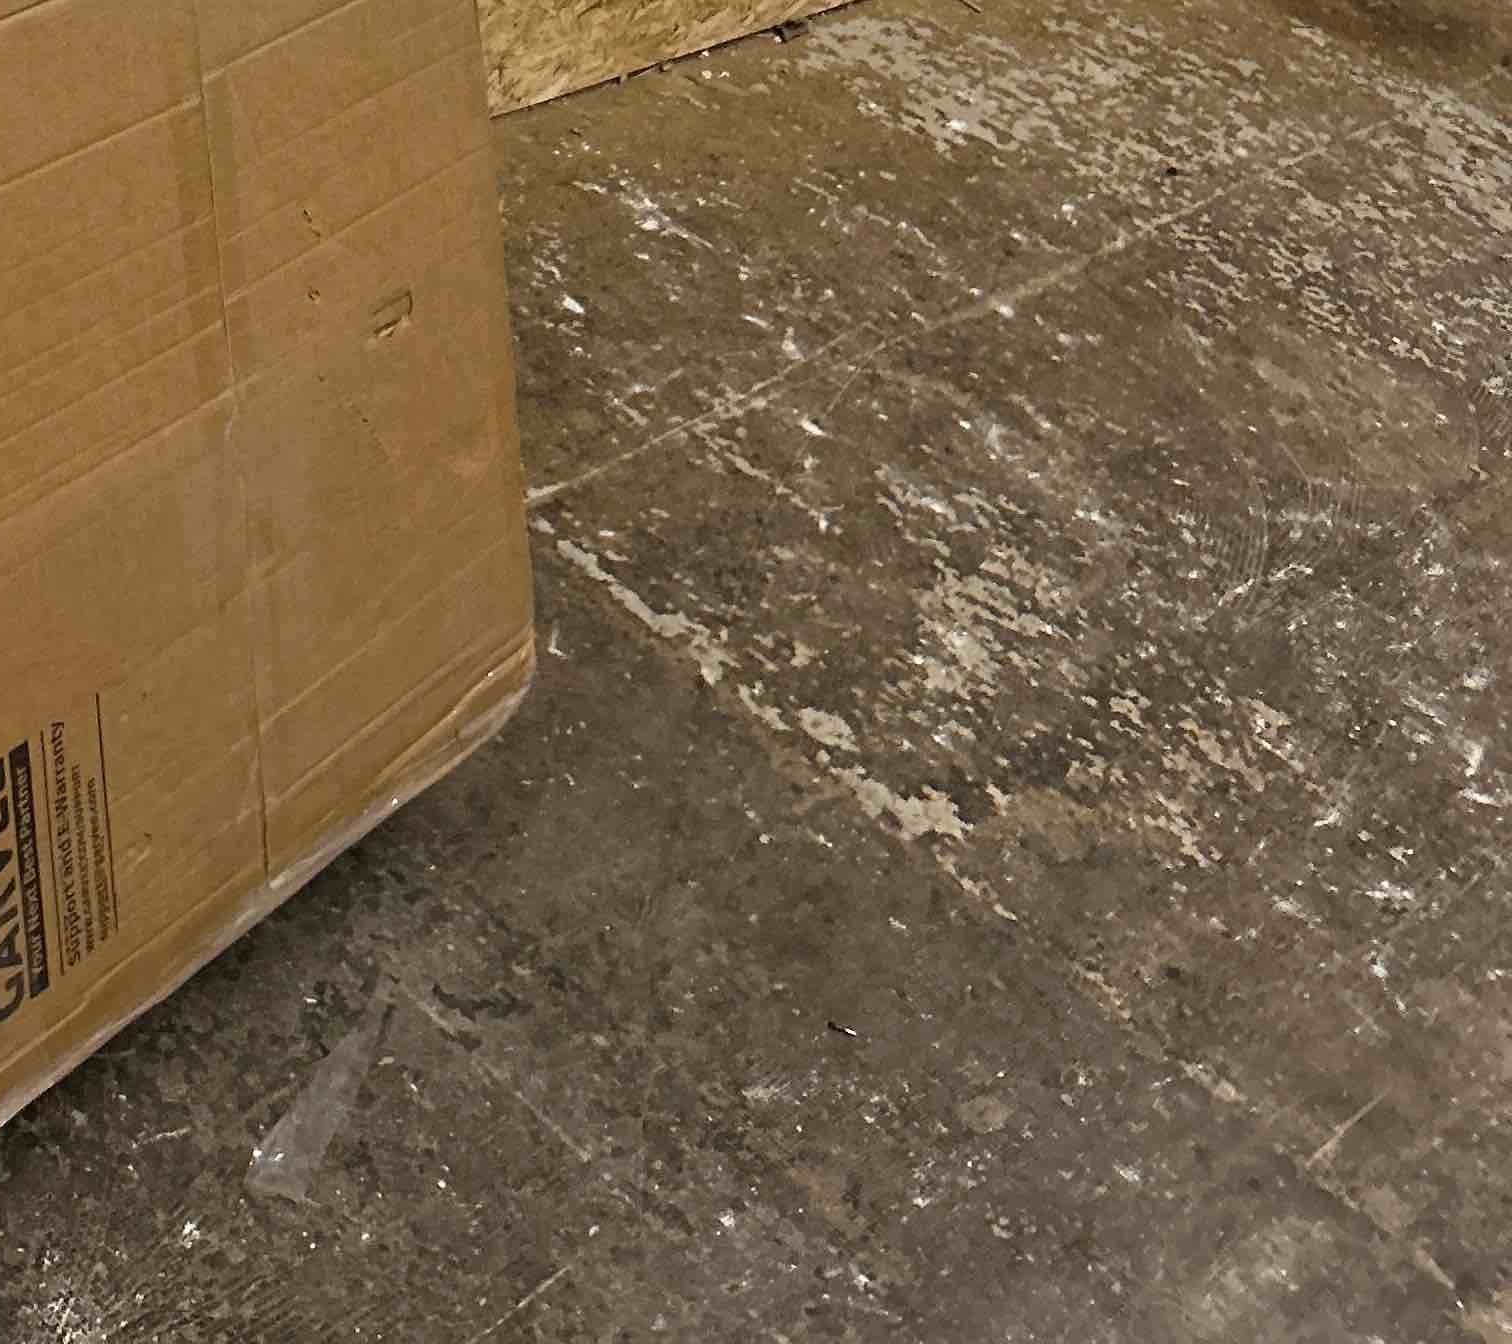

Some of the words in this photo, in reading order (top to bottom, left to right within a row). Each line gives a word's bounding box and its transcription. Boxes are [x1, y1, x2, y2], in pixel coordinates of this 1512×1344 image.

[15, 765, 34, 837] Partner
[49, 721, 72, 836] E-Warranty
[58, 839, 74, 876] and
[61, 882, 84, 967] Support
